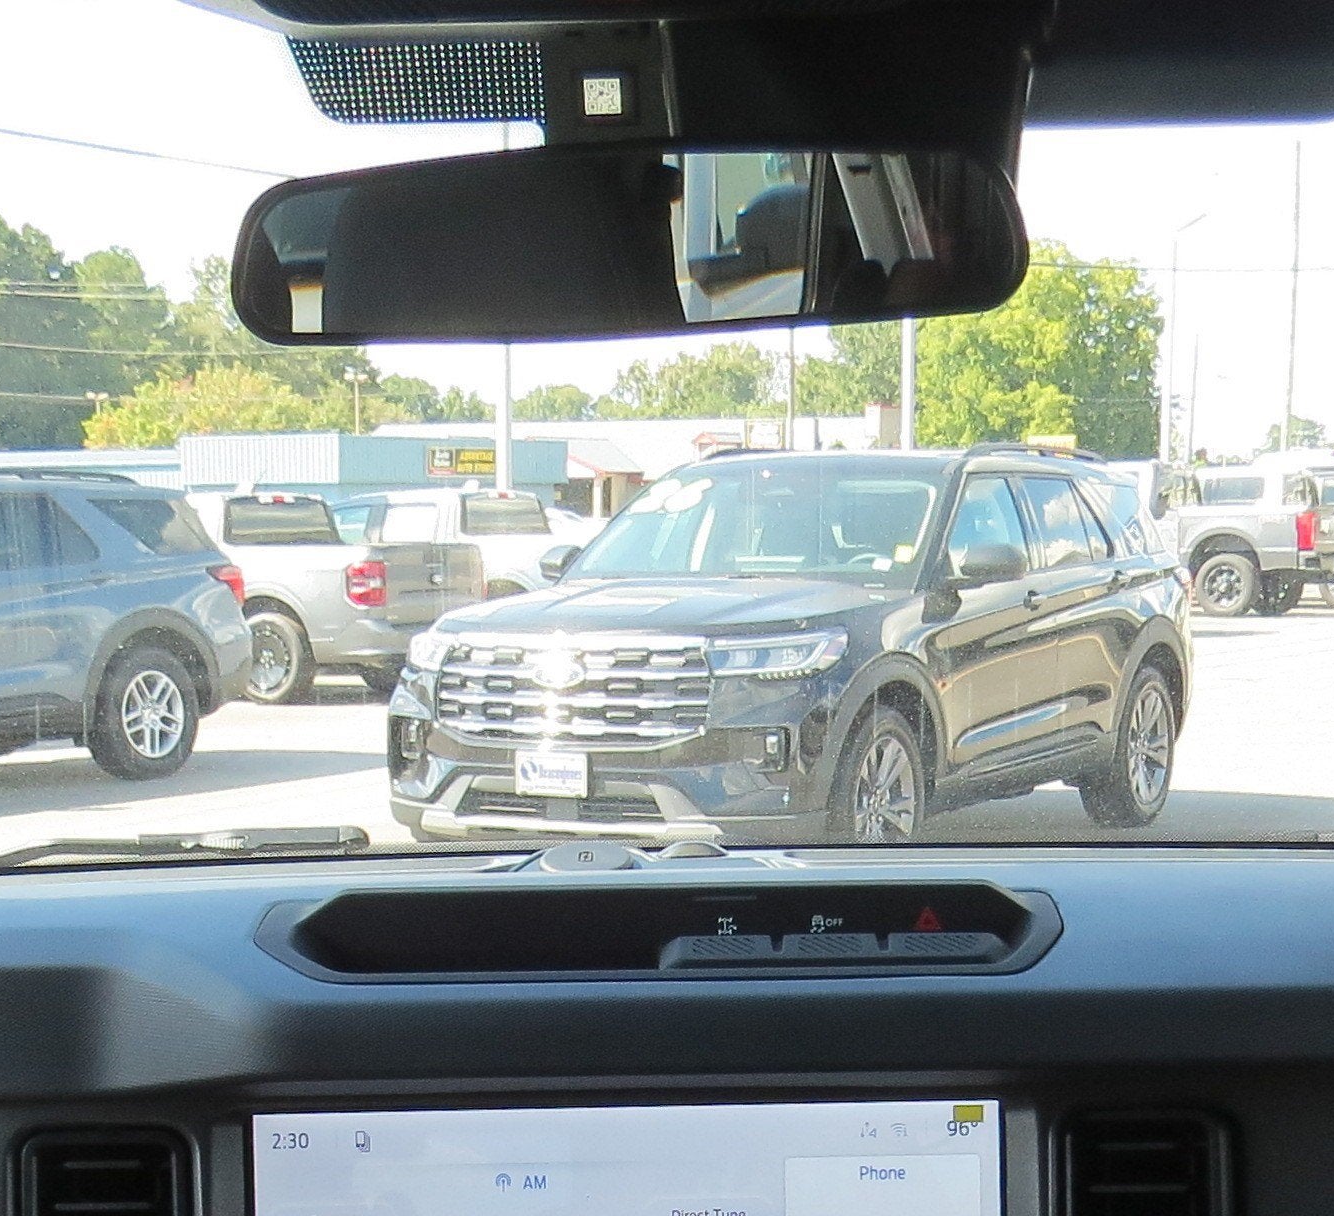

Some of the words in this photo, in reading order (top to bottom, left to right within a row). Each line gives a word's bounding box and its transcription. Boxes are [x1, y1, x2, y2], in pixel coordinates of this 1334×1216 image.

[825, 918, 844, 928] OFF
[271, 1132, 310, 1150] 2:30
[859, 1165, 906, 1181] Phone
[522, 1174, 547, 1190] AM
